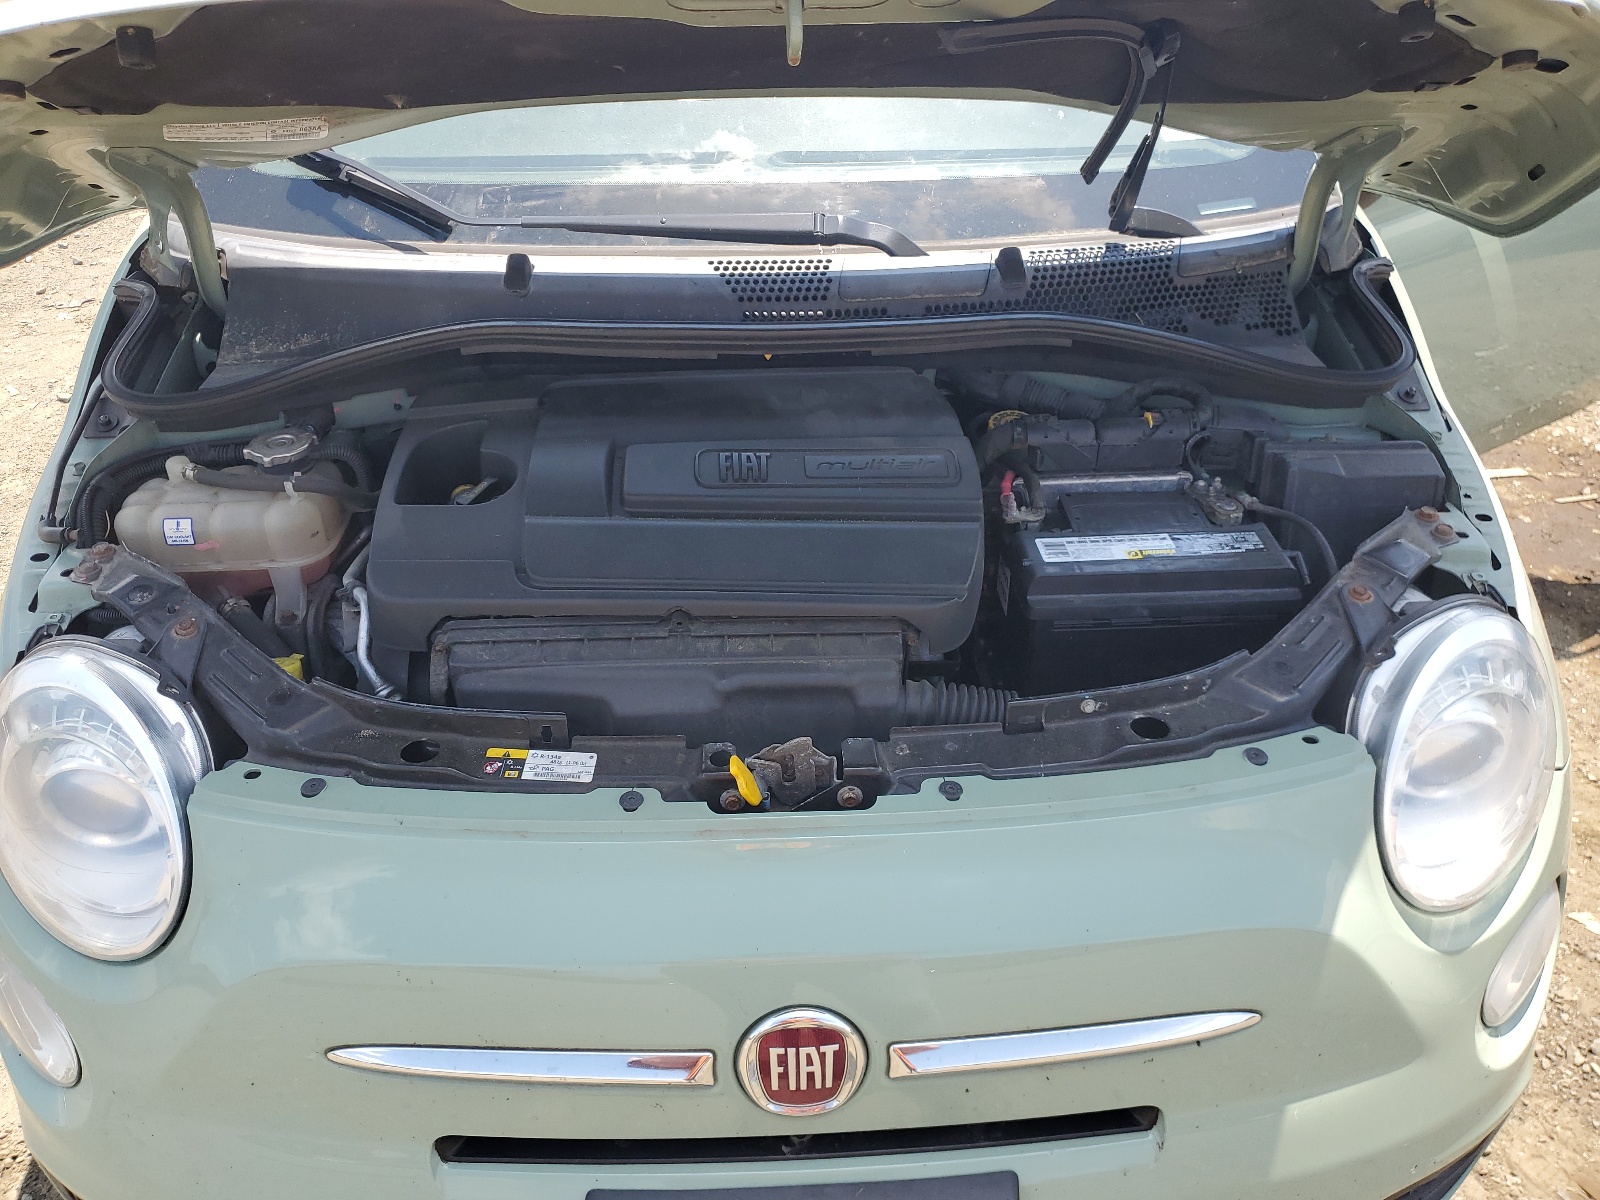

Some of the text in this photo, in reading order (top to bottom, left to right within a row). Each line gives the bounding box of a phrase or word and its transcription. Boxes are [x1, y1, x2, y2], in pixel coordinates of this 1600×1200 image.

[718, 452, 771, 483] FIAT
[816, 458, 936, 471] multiair
[768, 1043, 840, 1091] FIAT
